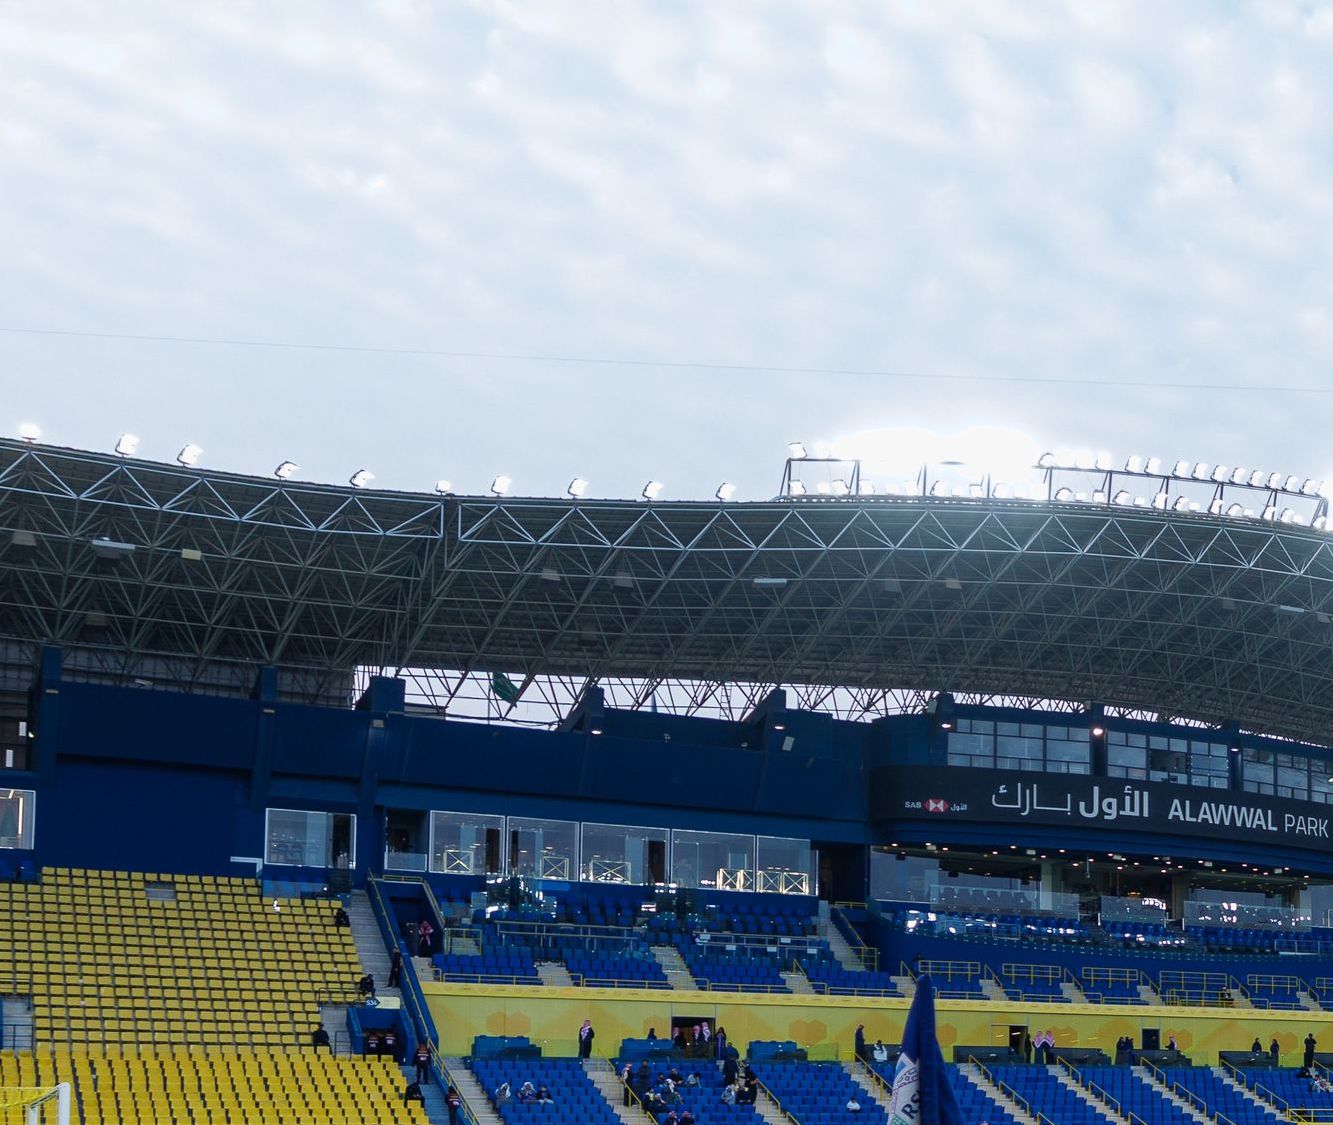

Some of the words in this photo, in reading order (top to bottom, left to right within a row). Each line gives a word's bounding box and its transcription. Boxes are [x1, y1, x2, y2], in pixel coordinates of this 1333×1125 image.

[904, 801, 922, 809] SAB
[991, 782, 1071, 816] بارك
[1079, 785, 1149, 820] الأول
[1167, 799, 1278, 832] ALAWWAL
[1284, 813, 1329, 839] PARK
